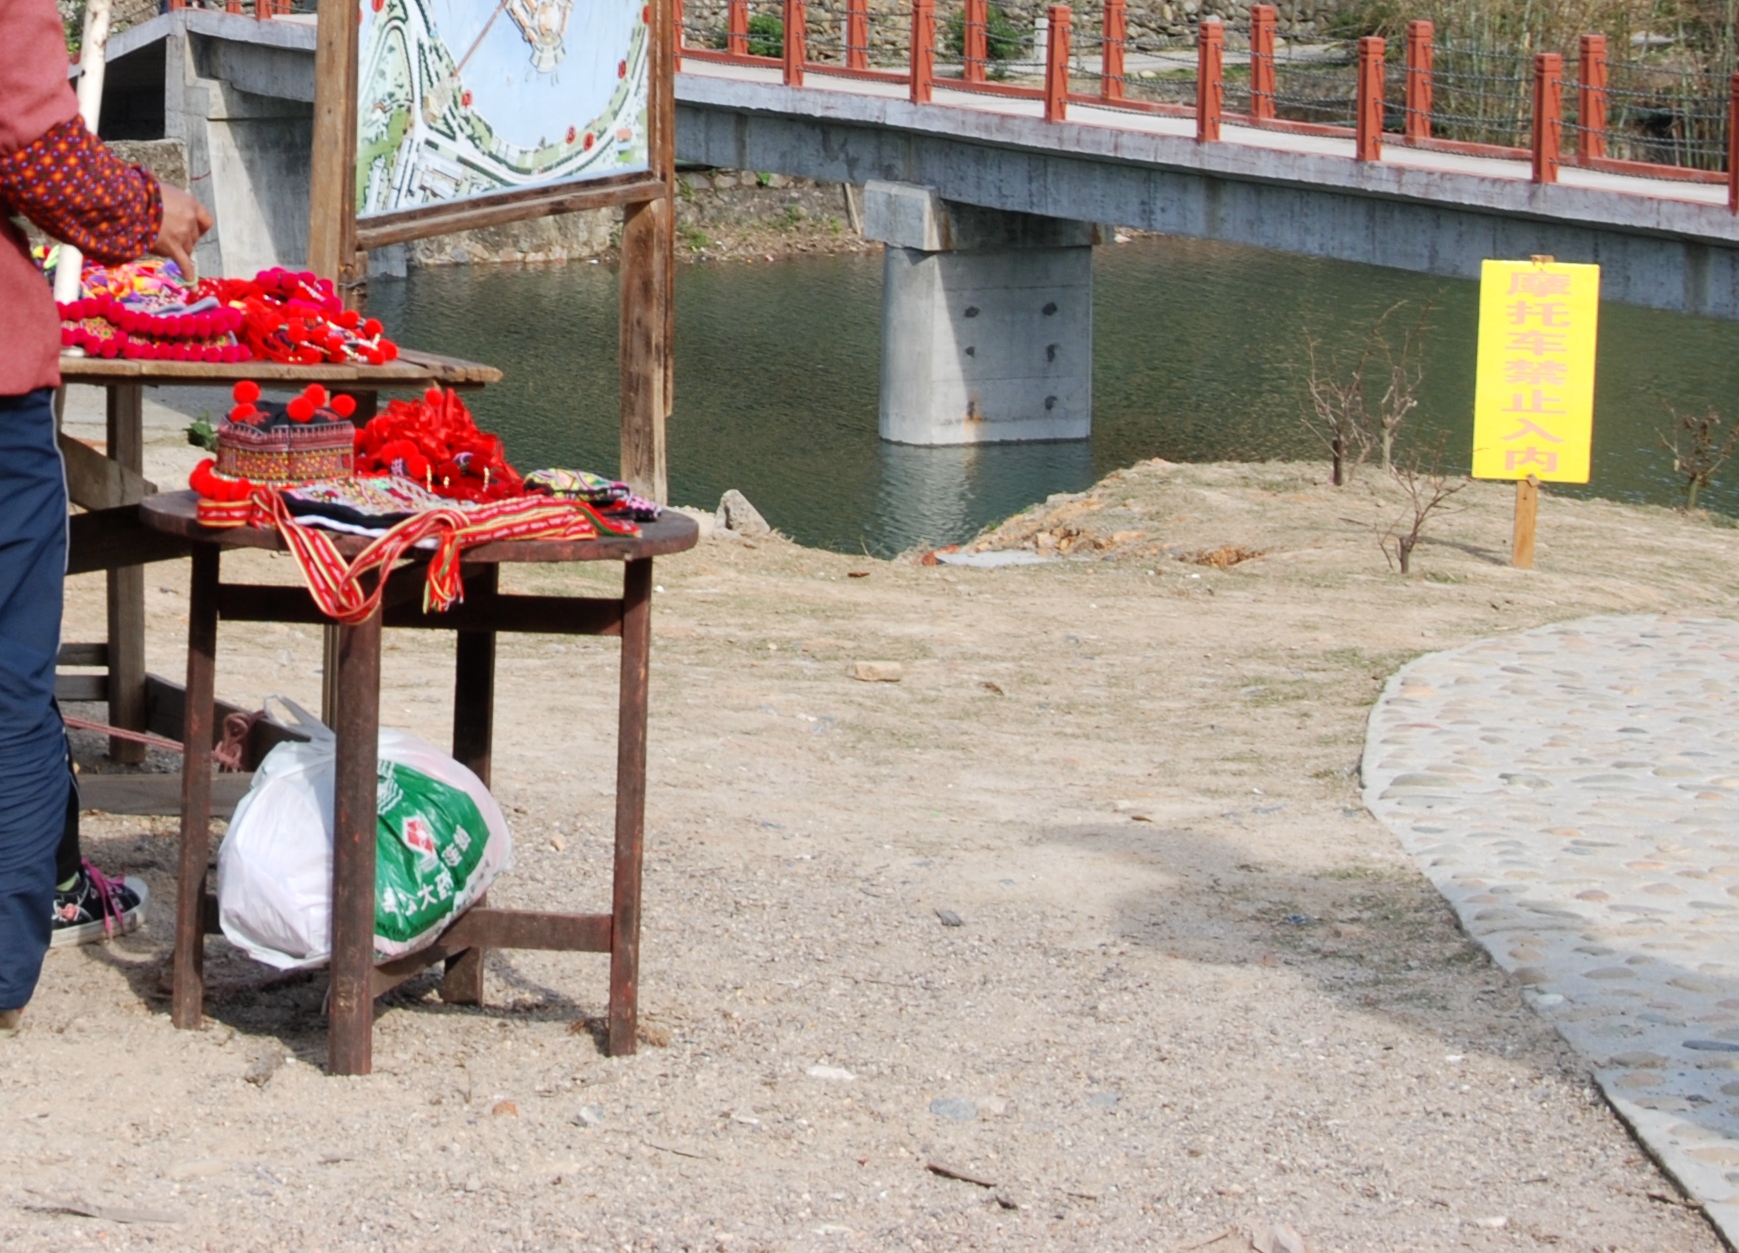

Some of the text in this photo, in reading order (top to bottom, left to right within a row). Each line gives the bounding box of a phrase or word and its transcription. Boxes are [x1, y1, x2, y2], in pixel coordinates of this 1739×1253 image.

[1501, 271, 1572, 473] 摩托车禁止入内
